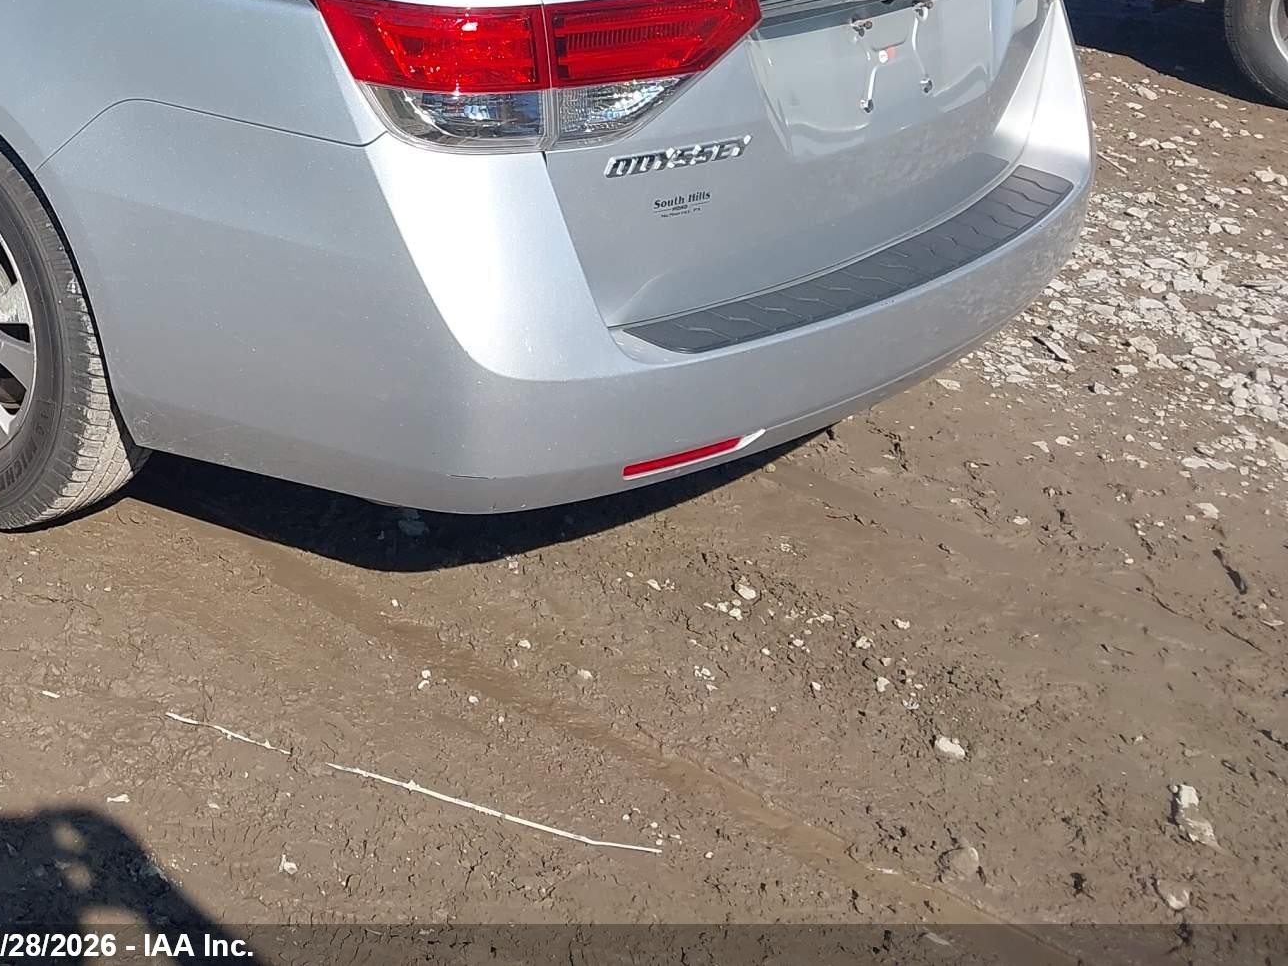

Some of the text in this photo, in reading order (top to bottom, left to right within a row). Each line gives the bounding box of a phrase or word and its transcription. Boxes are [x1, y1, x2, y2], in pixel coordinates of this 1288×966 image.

[603, 134, 753, 178] ODYSSEY
[653, 195, 685, 210] South
[688, 191, 711, 202] Hills
